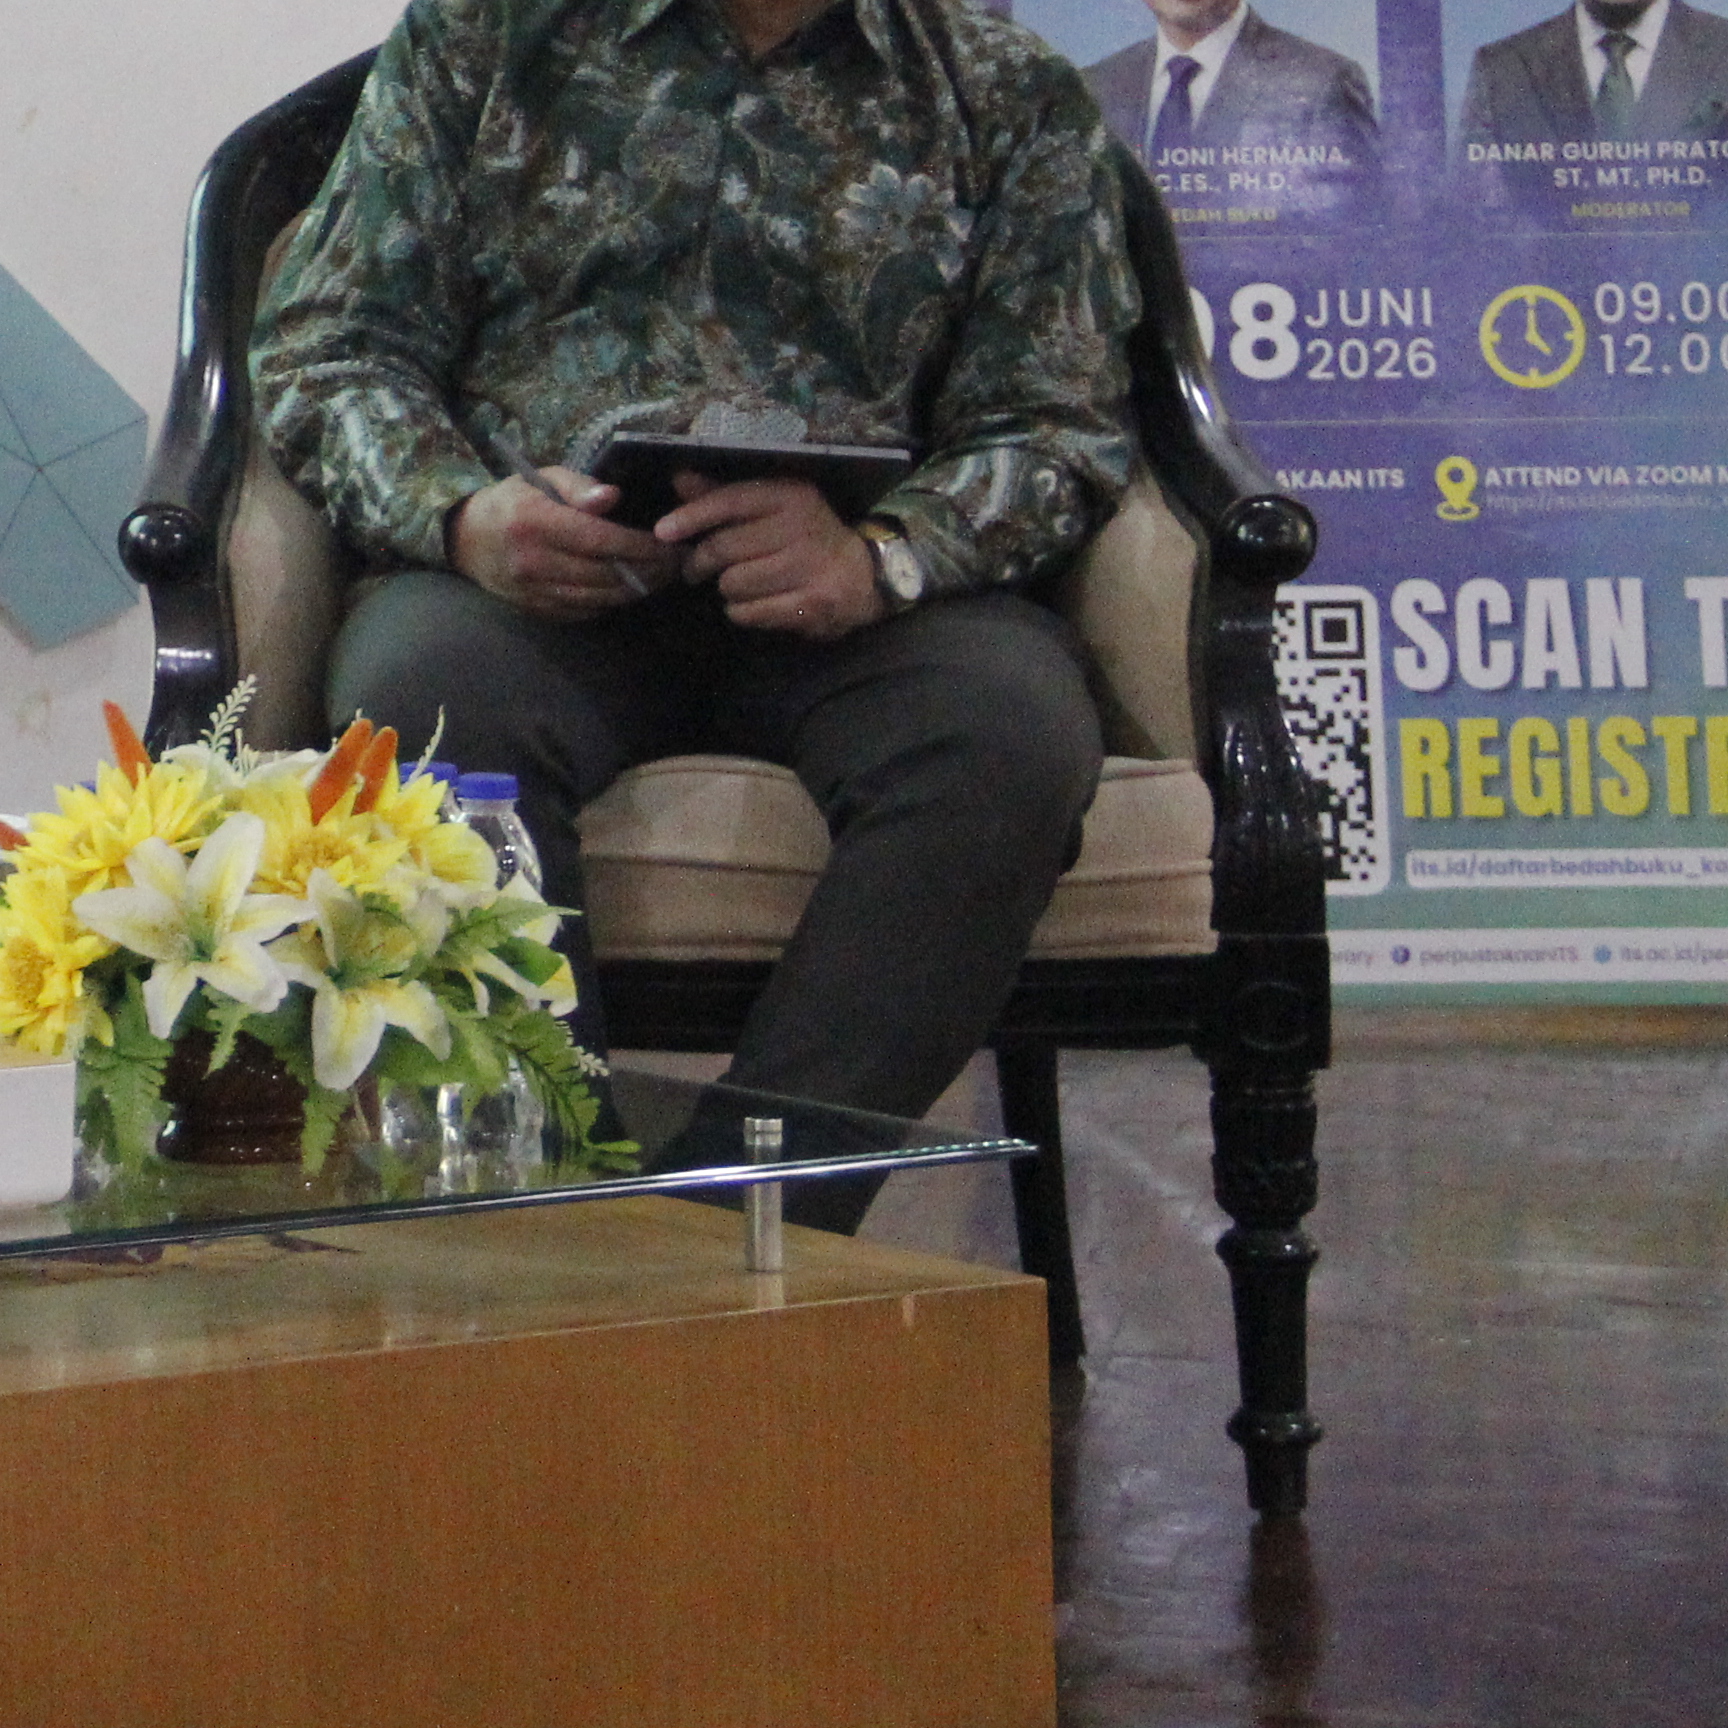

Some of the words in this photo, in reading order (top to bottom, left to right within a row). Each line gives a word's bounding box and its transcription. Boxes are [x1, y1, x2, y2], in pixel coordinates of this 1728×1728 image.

[1156, 146, 1215, 167] JONI
[1467, 142, 1555, 162] DANAR
[1562, 141, 1651, 161] GURUH
[1303, 287, 1433, 329] JUNI
[1306, 337, 1437, 381] 2026
[1367, 467, 1405, 488] ITS
[1484, 466, 1582, 487] ATTEND
[1585, 465, 1630, 486] VIA
[1636, 464, 1713, 486] ZOOM
[1390, 576, 1648, 693] SCAN
